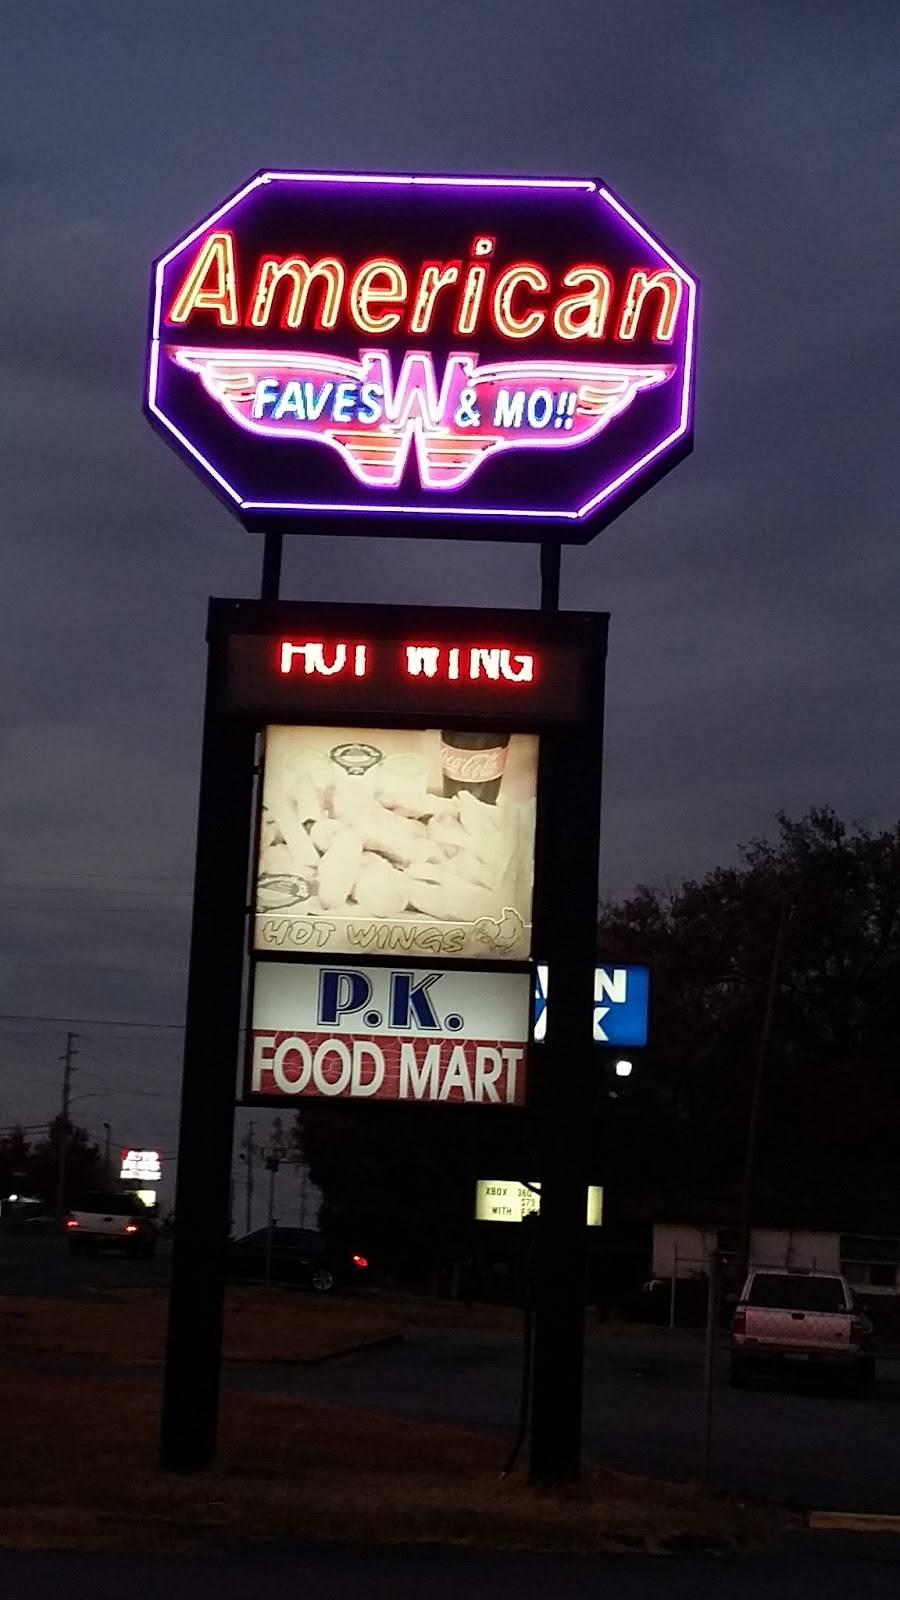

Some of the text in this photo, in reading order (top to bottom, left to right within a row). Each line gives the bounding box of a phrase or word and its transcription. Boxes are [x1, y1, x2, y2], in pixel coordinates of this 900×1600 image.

[167, 230, 684, 343] American
[252, 377, 578, 430] FAVES & MO!!
[406, 646, 533, 681] WING
[262, 919, 466, 953] HOT WINGS
[317, 968, 464, 1032] P.K.
[251, 1036, 524, 1103] FOOD MART
[485, 1187, 508, 1196] XBOX
[491, 1207, 512, 1216] WITH
